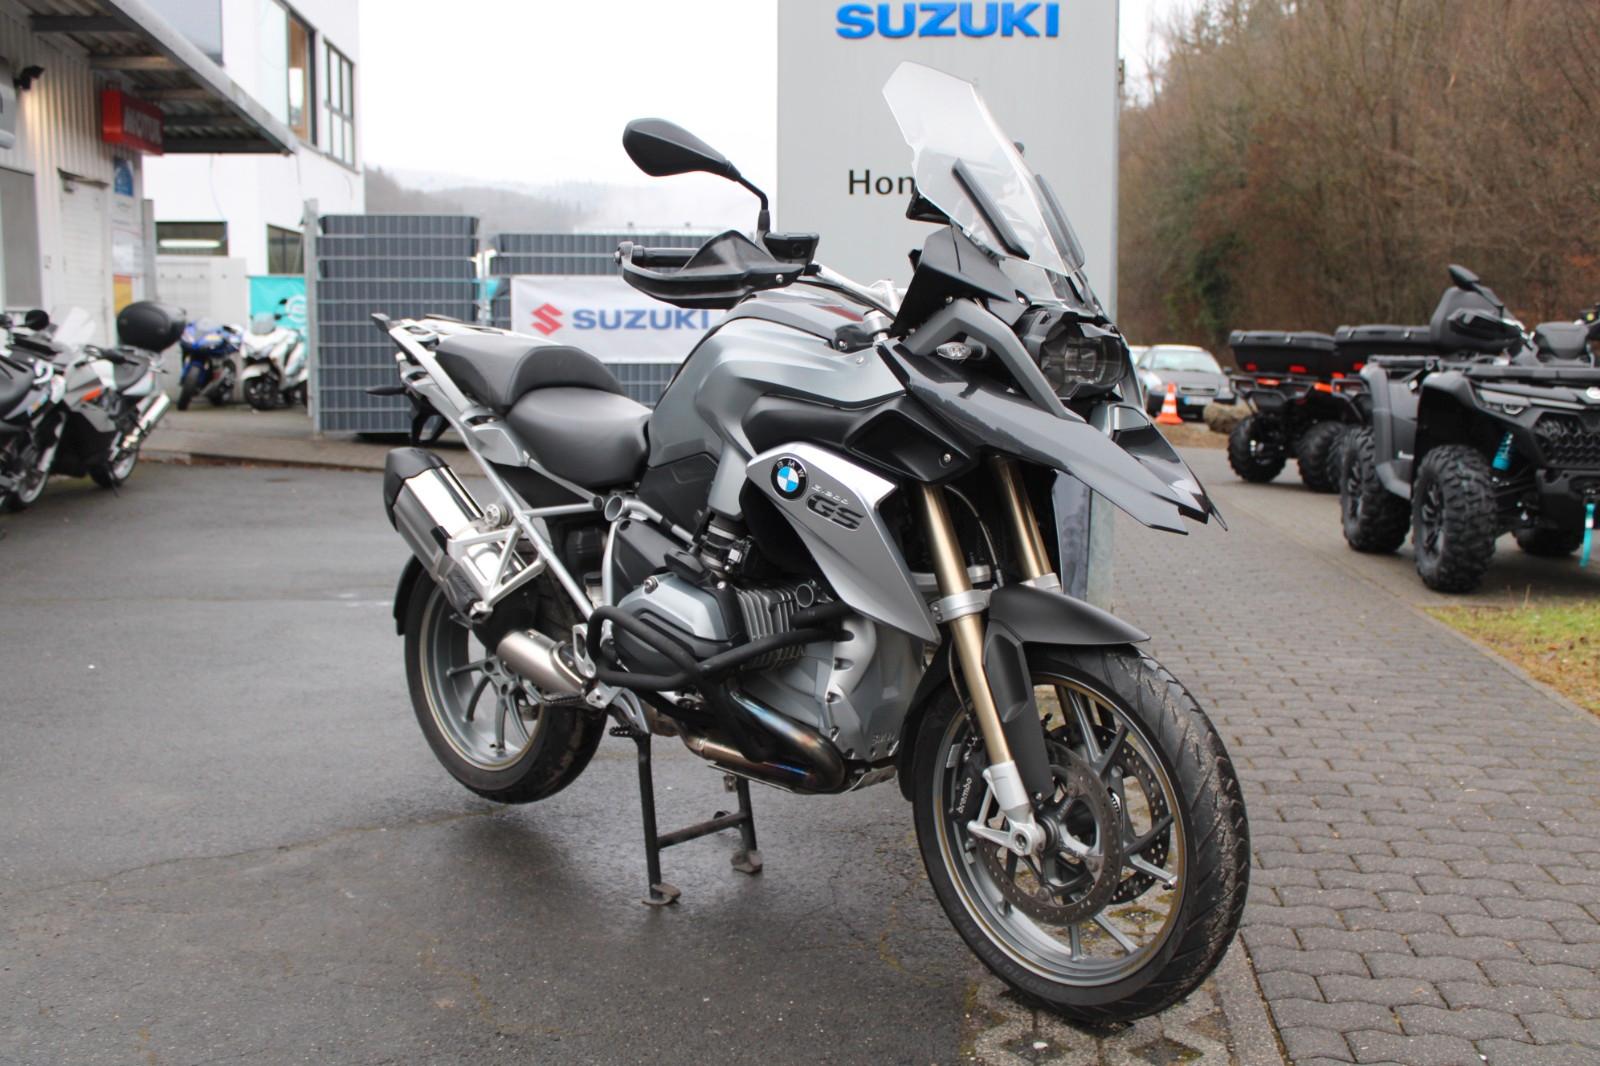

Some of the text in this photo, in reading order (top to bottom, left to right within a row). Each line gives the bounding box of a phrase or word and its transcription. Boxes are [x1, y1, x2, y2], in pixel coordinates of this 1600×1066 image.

[835, 2, 1060, 39] SUZUKI
[572, 308, 709, 330] SUZUKI
[777, 459, 806, 478] BMW
[807, 494, 864, 530] GS
[955, 777, 972, 814] brembo
